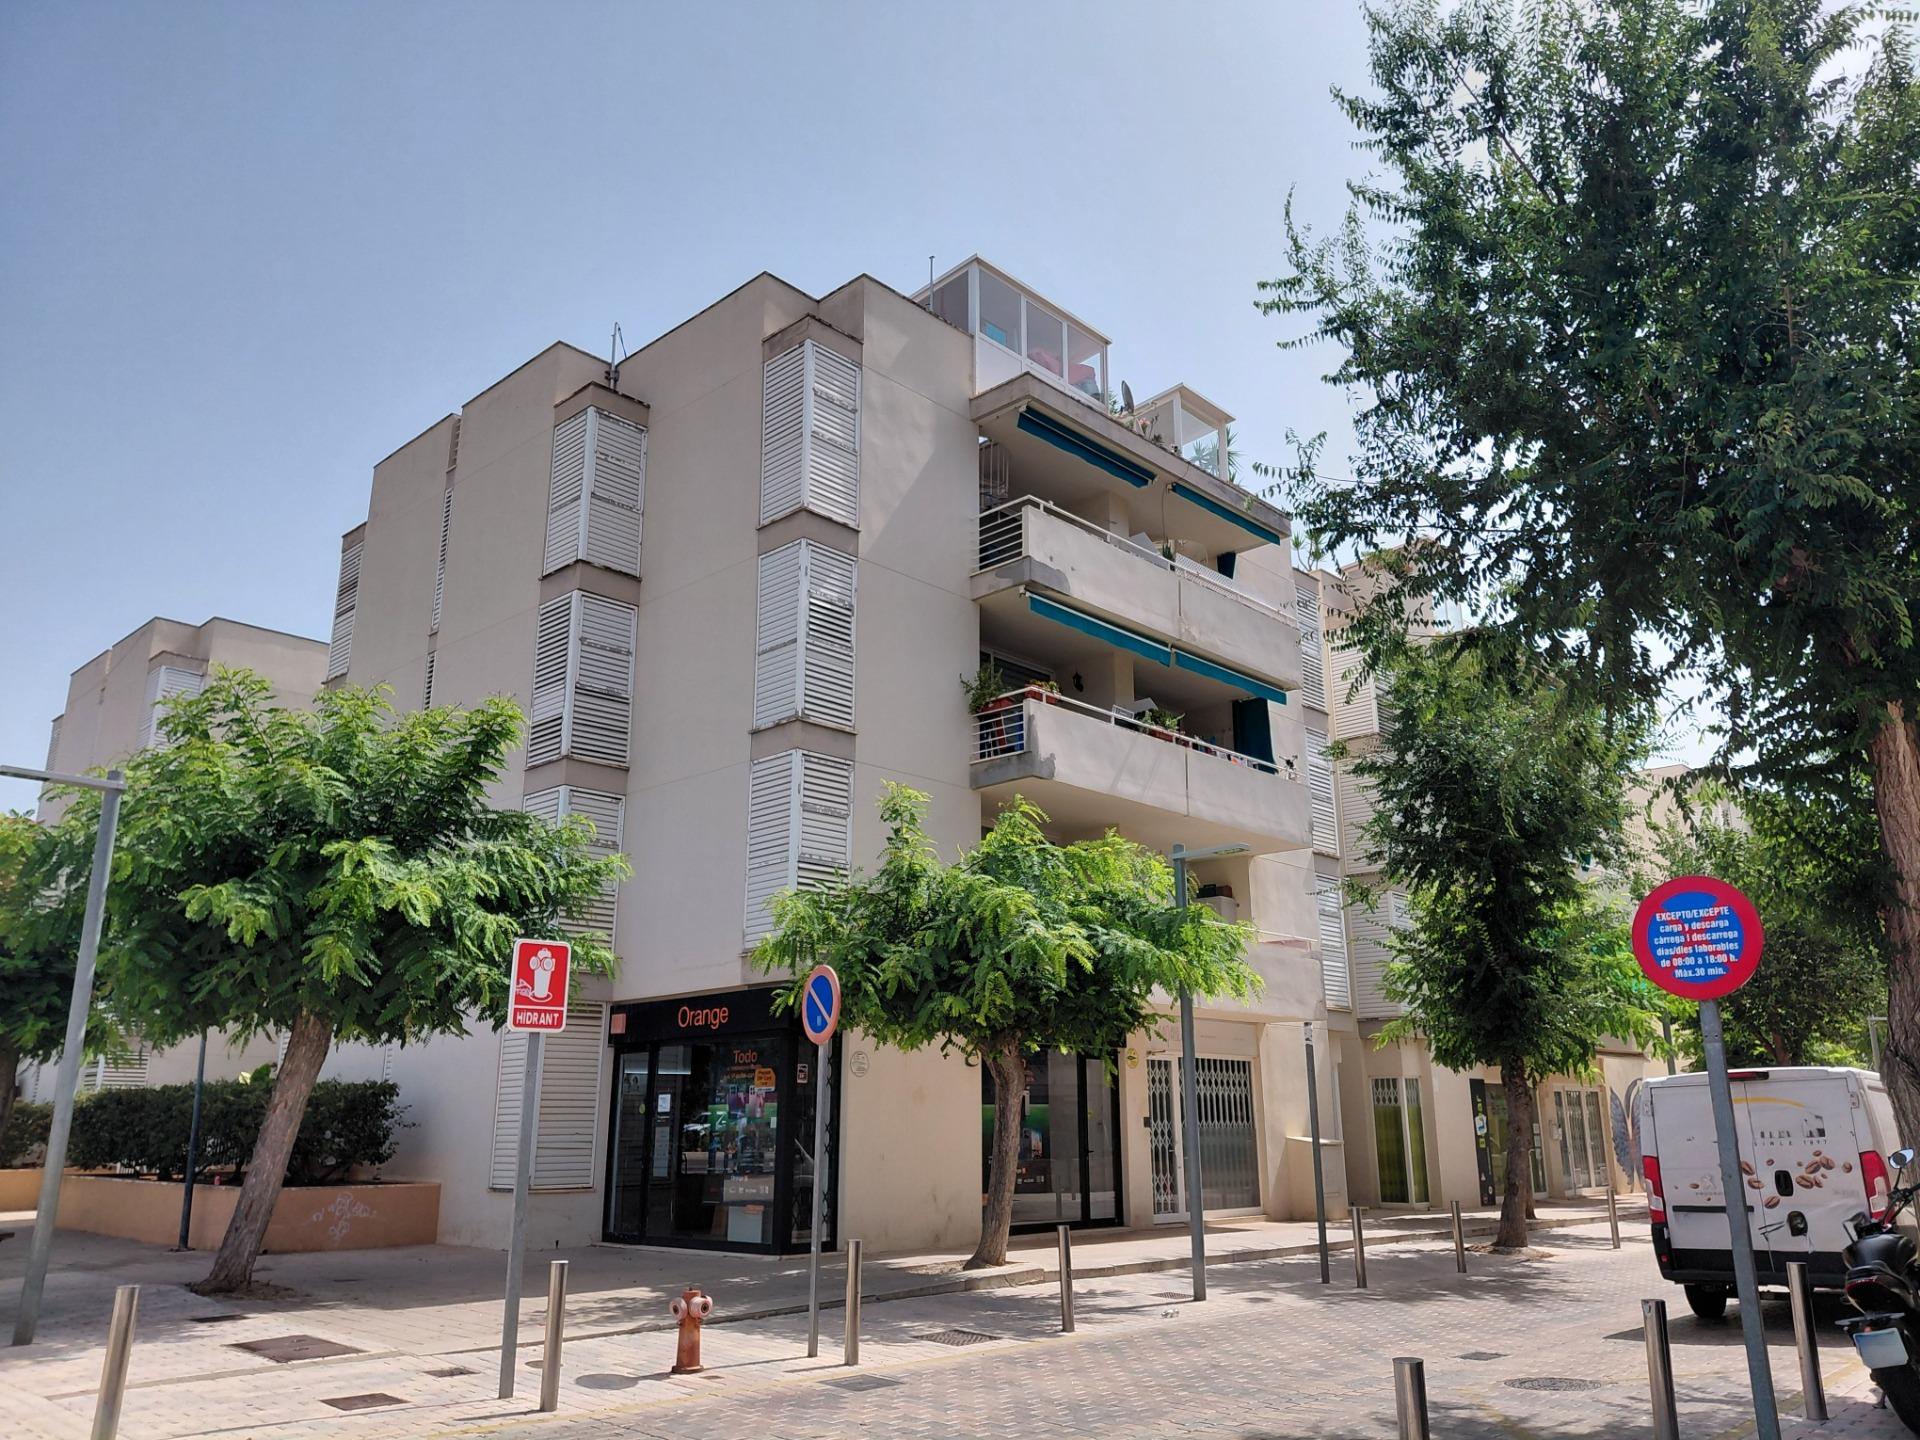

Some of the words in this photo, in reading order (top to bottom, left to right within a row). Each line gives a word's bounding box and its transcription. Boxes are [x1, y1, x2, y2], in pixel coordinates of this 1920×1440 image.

[1659, 924, 1682, 933] carga
[1684, 924, 1689, 932] y
[1691, 919, 1729, 930] descarga
[1695, 941, 1739, 954] laborables
[1660, 958, 1671, 968] de
[1672, 956, 1695, 967] 08:00
[1697, 957, 1703, 965] a
[1704, 953, 1727, 965] 18:00
[1707, 966, 1726, 976] min.
[678, 1006, 729, 1030] Orange
[733, 1049, 758, 1064] Todo
